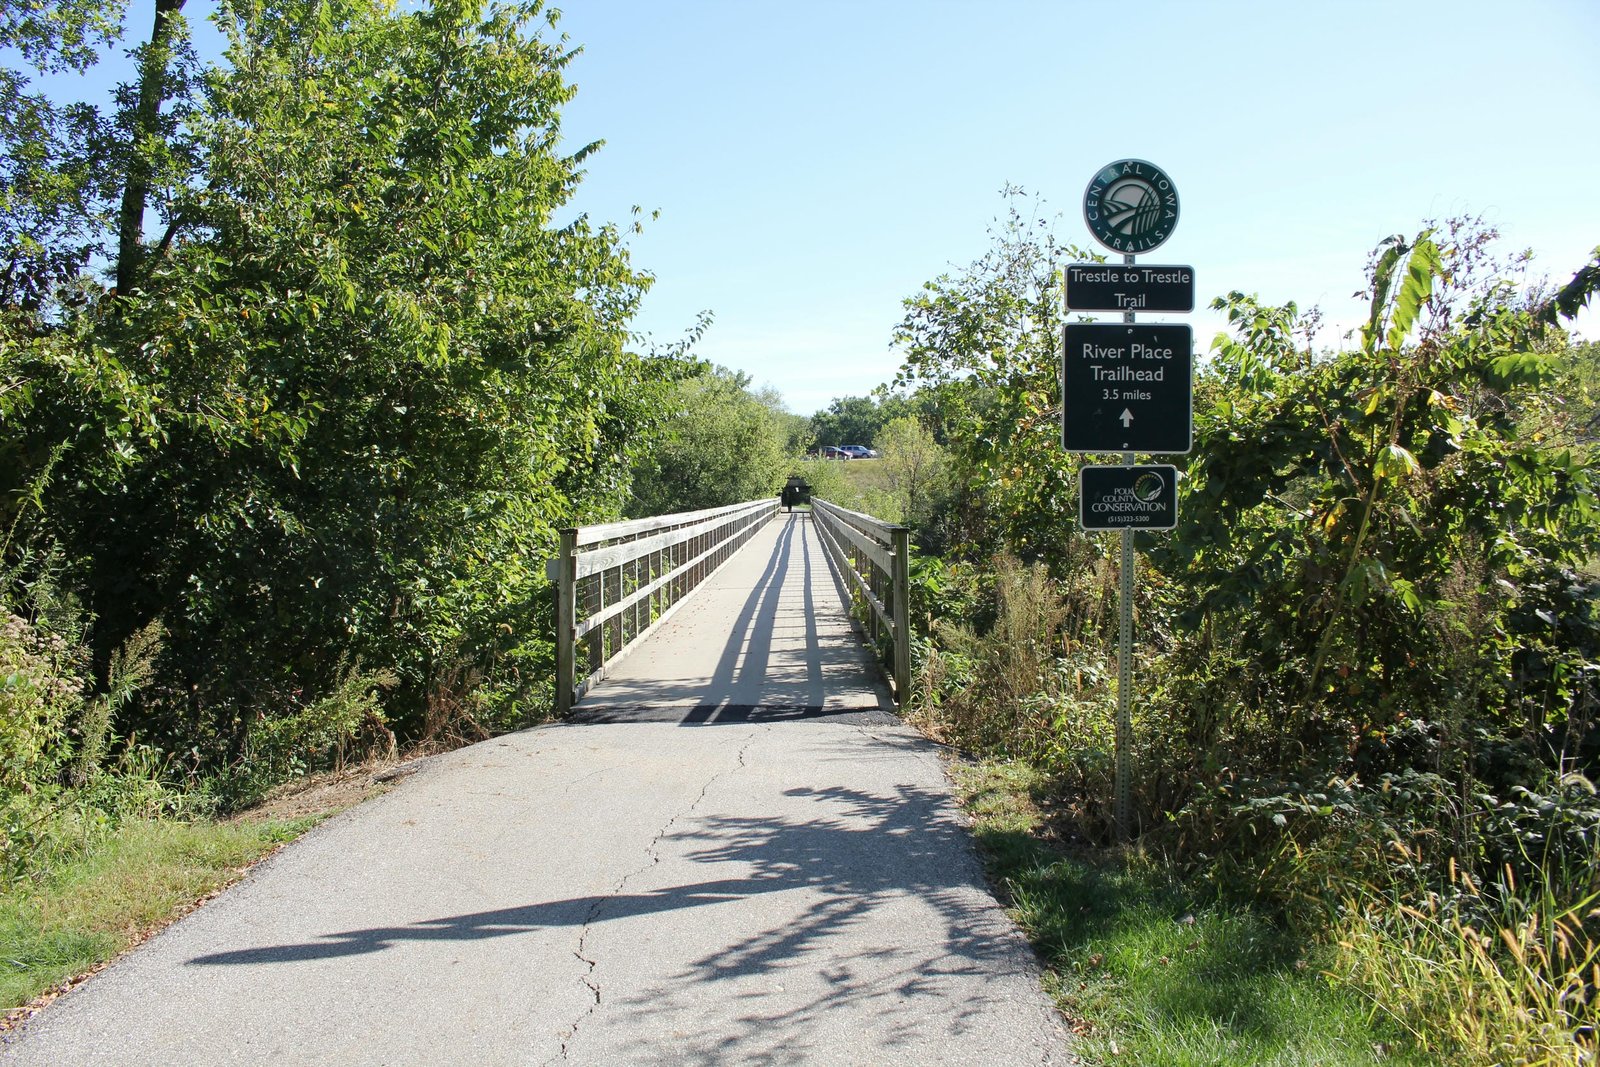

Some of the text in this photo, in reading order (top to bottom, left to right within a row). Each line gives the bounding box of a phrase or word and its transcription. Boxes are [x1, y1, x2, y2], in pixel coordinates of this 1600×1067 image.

[1088, 164, 1176, 221] CENTRAL IOWA
[1103, 231, 1164, 251] TRAILS
[1071, 269, 1189, 283] Trestle to Trestle
[1114, 293, 1145, 307] Trail
[1083, 343, 1172, 359] River Place
[1090, 366, 1163, 381] Trailhead
[1103, 389, 1151, 400] 3.5 miles
[1092, 502, 1166, 512] CONSERVATION
